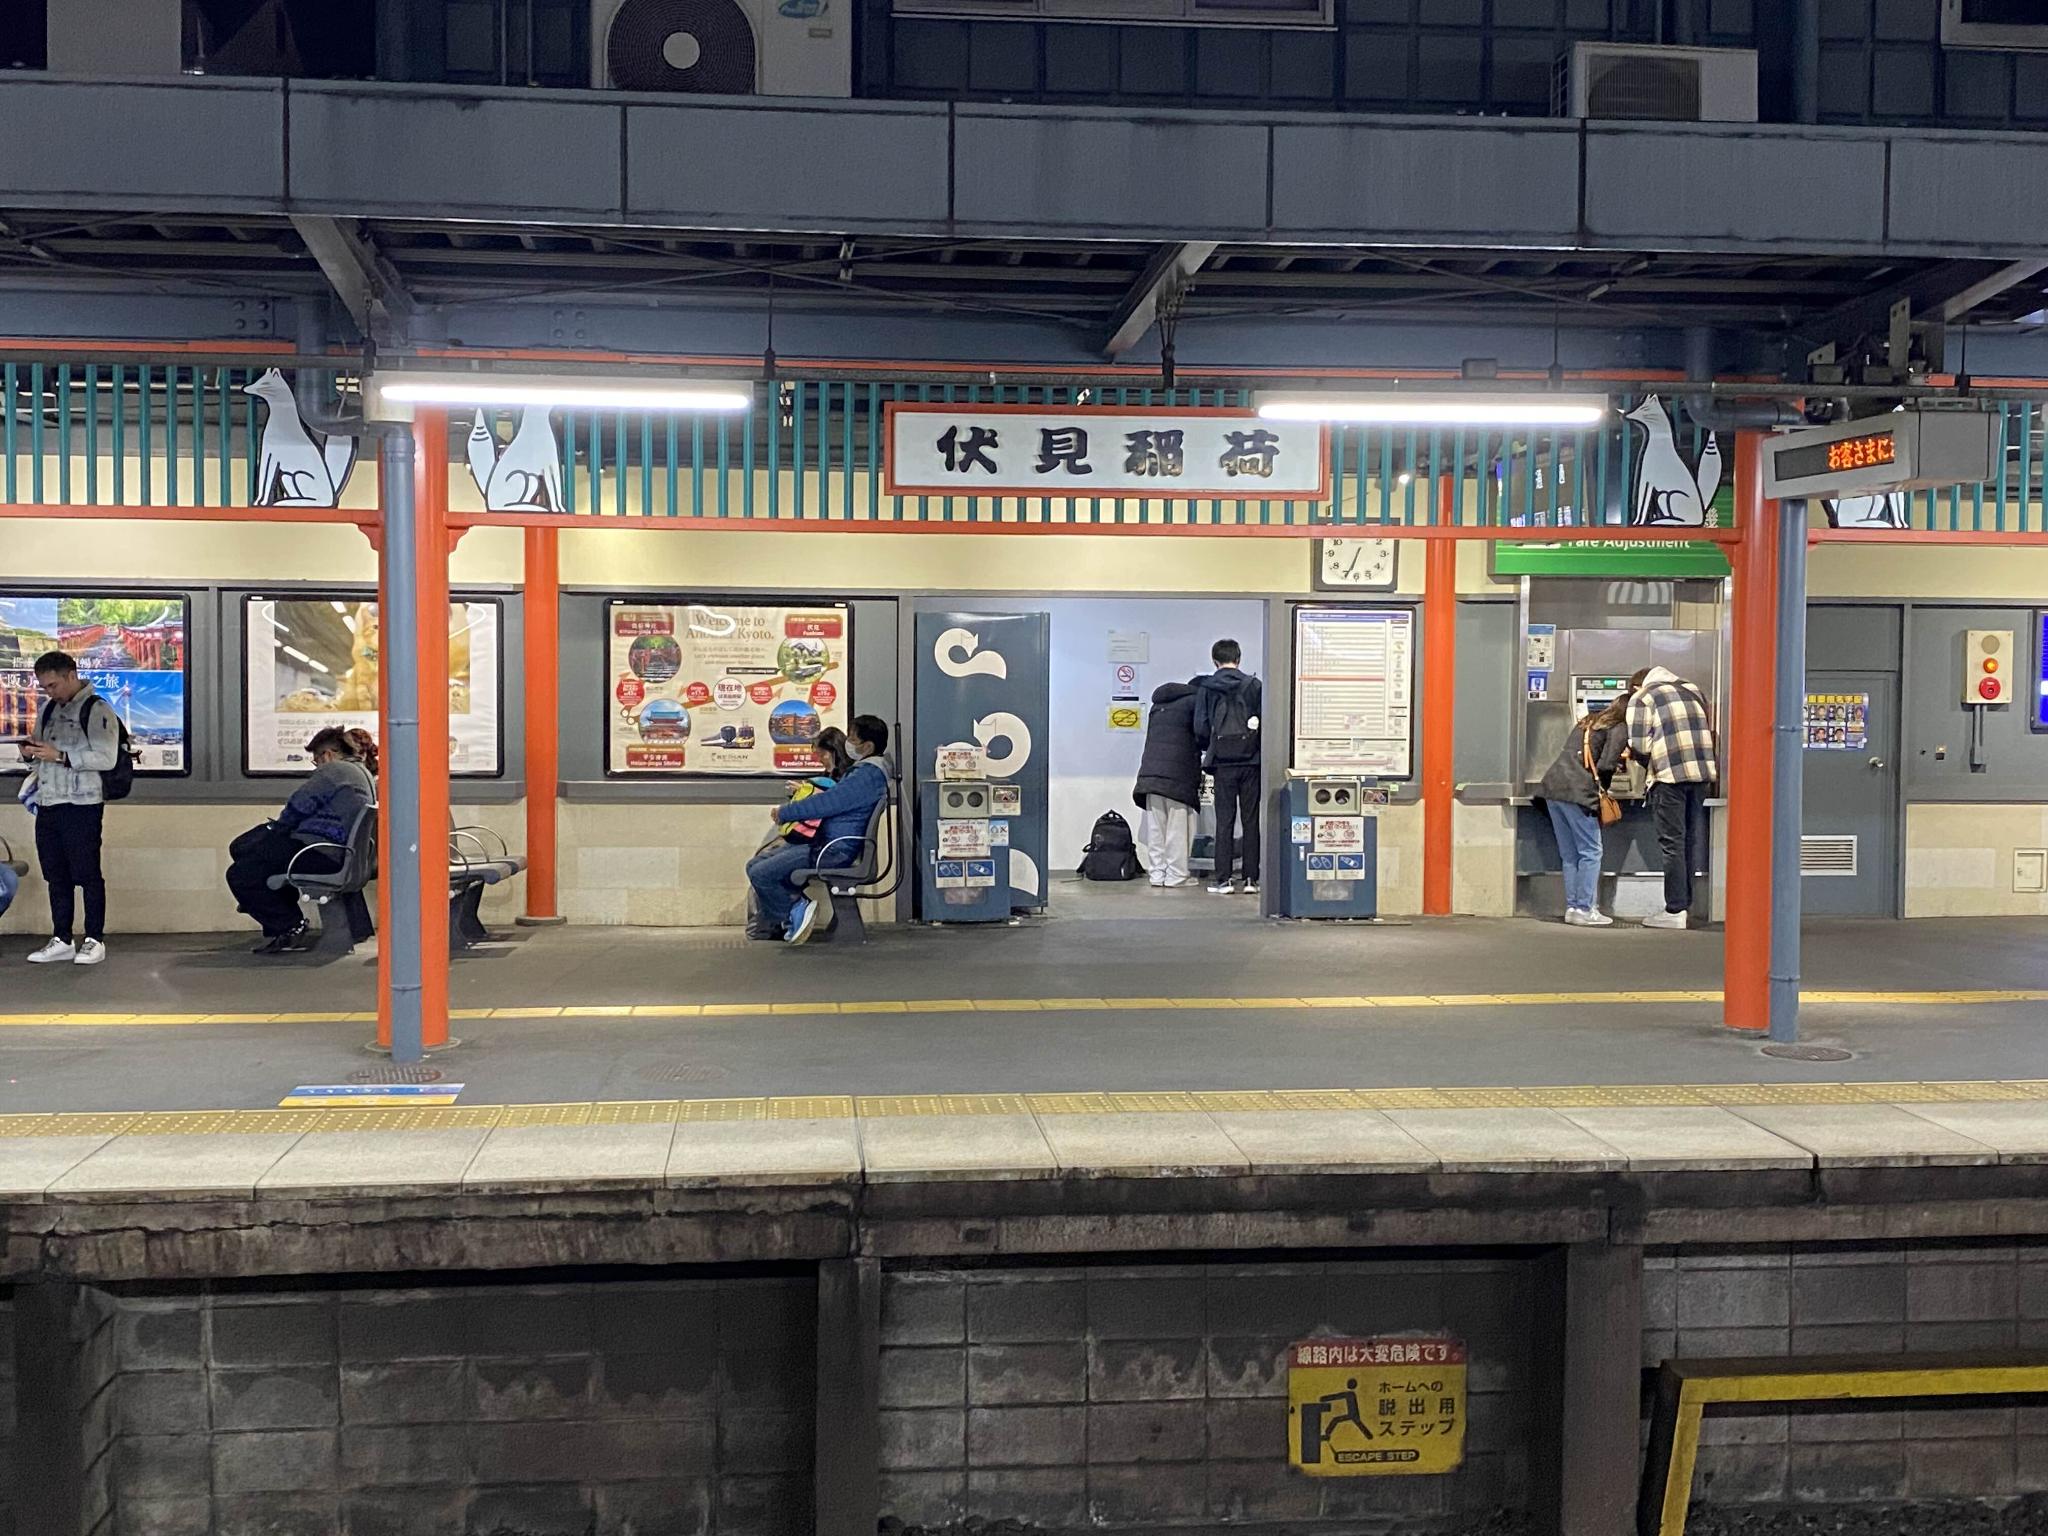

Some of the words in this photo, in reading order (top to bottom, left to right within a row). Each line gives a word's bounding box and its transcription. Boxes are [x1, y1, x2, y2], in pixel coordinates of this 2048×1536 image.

[936, 424, 1280, 478] 伏見稲荷
[1603, 540, 1690, 551] Adjustment
[753, 616, 766, 626] to
[737, 628, 774, 642] Kyoto.
[1378, 1380, 1444, 1394] ホームへの
[1378, 1397, 1456, 1416] 脱出用
[1379, 1418, 1456, 1437] ステップ
[1338, 1452, 1382, 1462] ESCAPE
[1387, 1451, 1417, 1460] STEP
